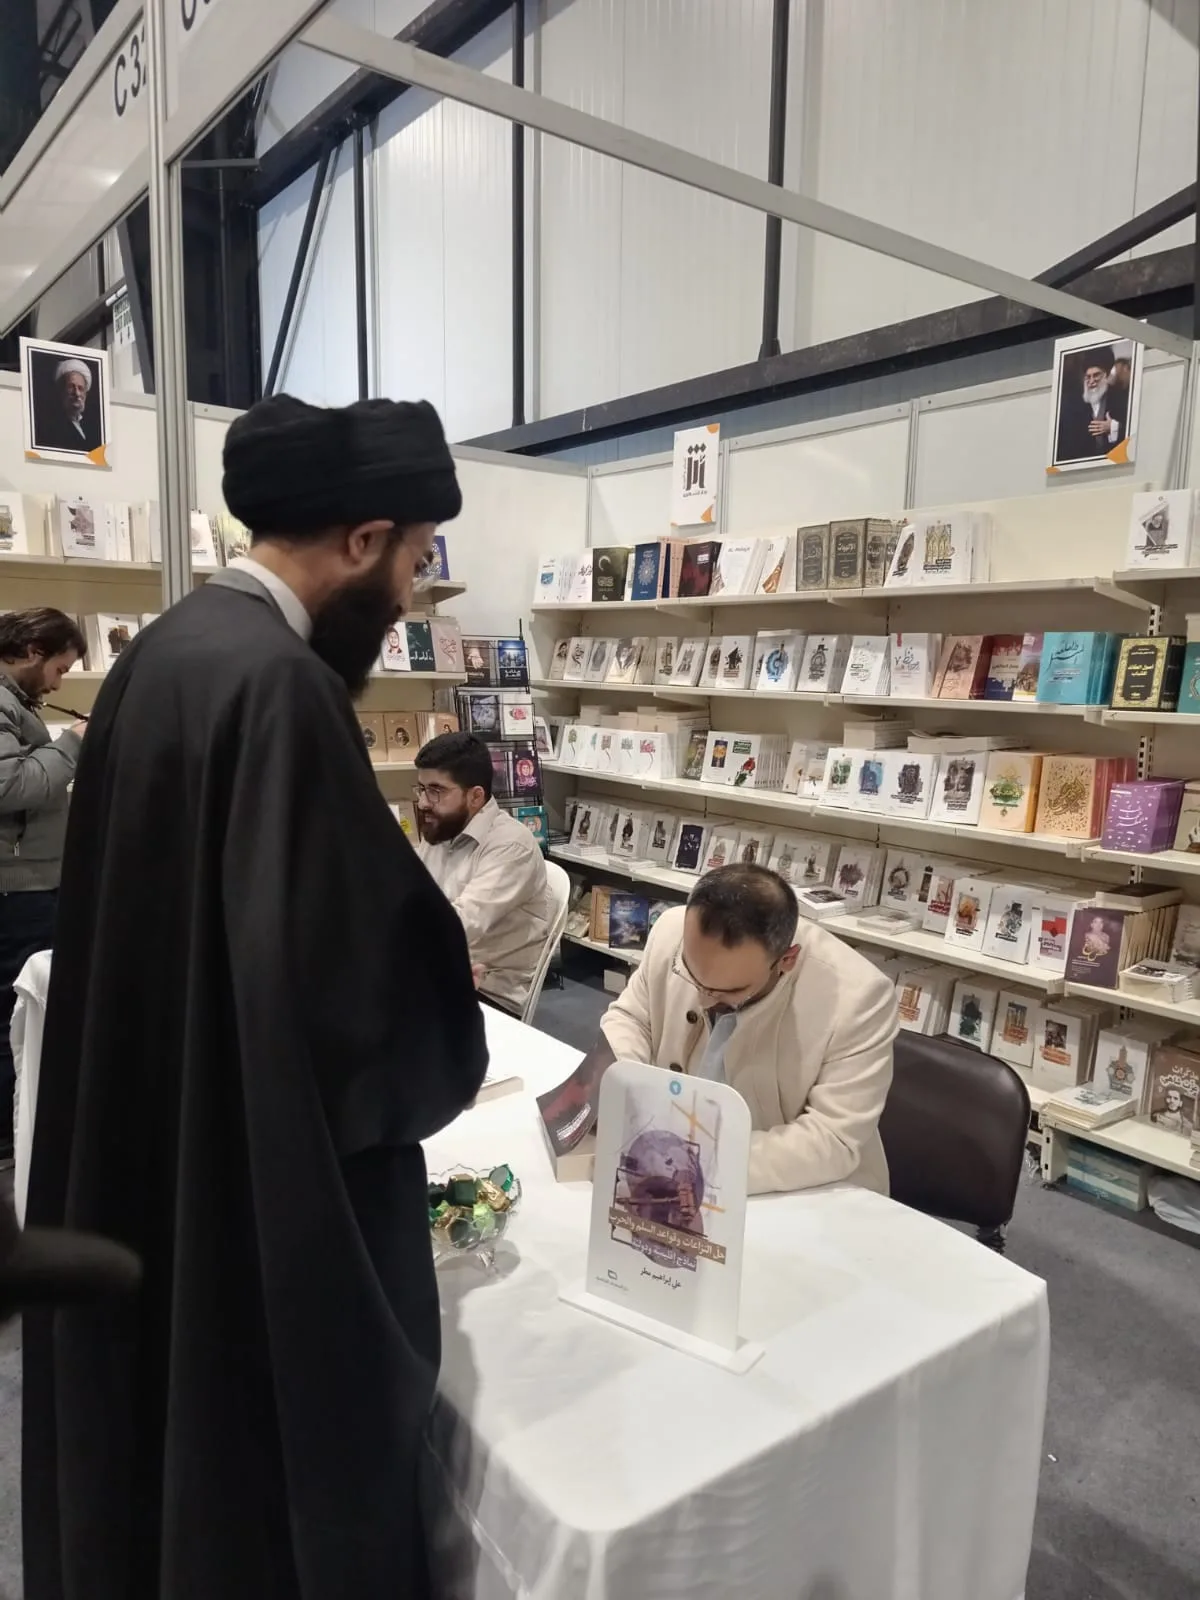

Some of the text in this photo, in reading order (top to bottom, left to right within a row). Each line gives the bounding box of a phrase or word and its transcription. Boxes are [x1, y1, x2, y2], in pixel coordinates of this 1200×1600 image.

[115, 24, 147, 117] C3
[609, 1215, 636, 1230] والحرب
[635, 1224, 656, 1234] السلم
[657, 1230, 681, 1246] وقواعد
[682, 1240, 712, 1255] النزاعات
